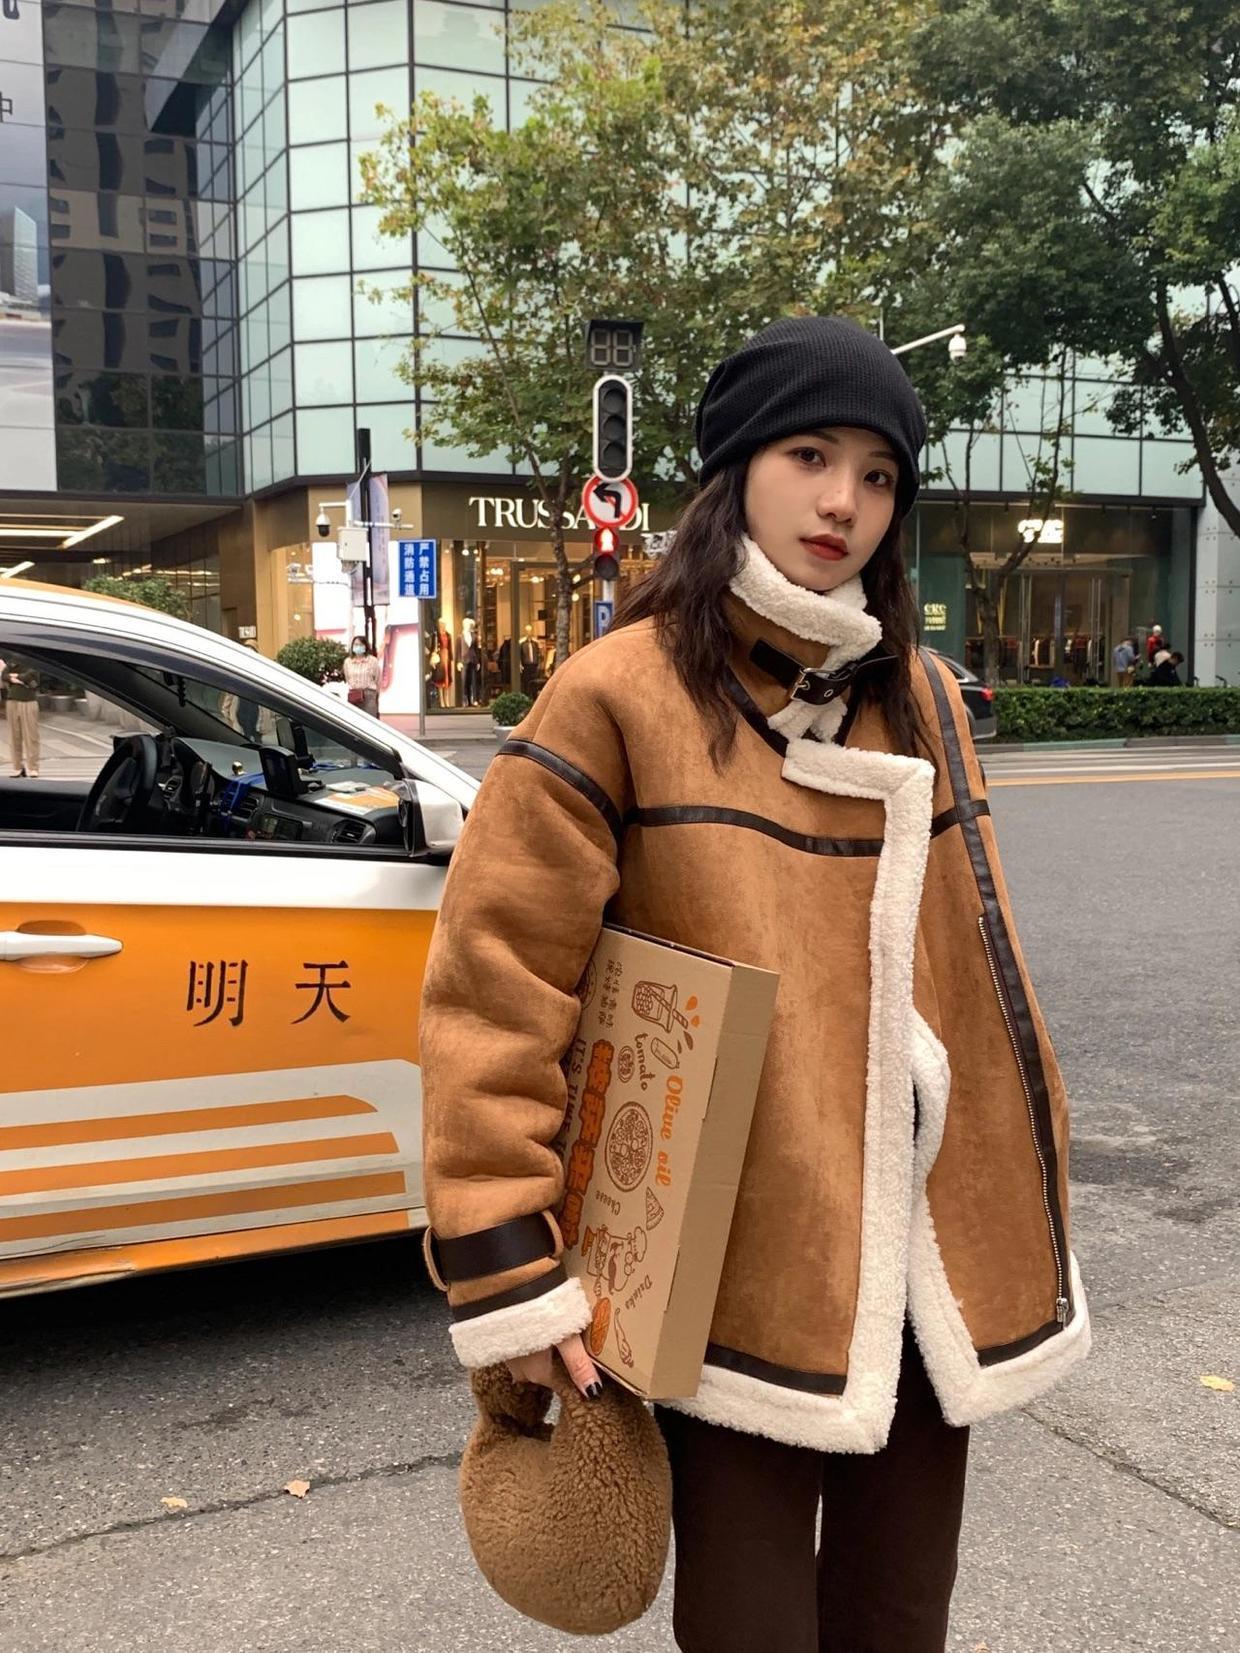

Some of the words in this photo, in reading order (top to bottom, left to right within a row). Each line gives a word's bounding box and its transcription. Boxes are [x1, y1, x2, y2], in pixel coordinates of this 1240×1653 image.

[403, 543, 415, 596] 消防通道
[419, 543, 430, 596] 严禁占用
[635, 1032, 656, 1091] tomato
[655, 1151, 673, 1188] oil
